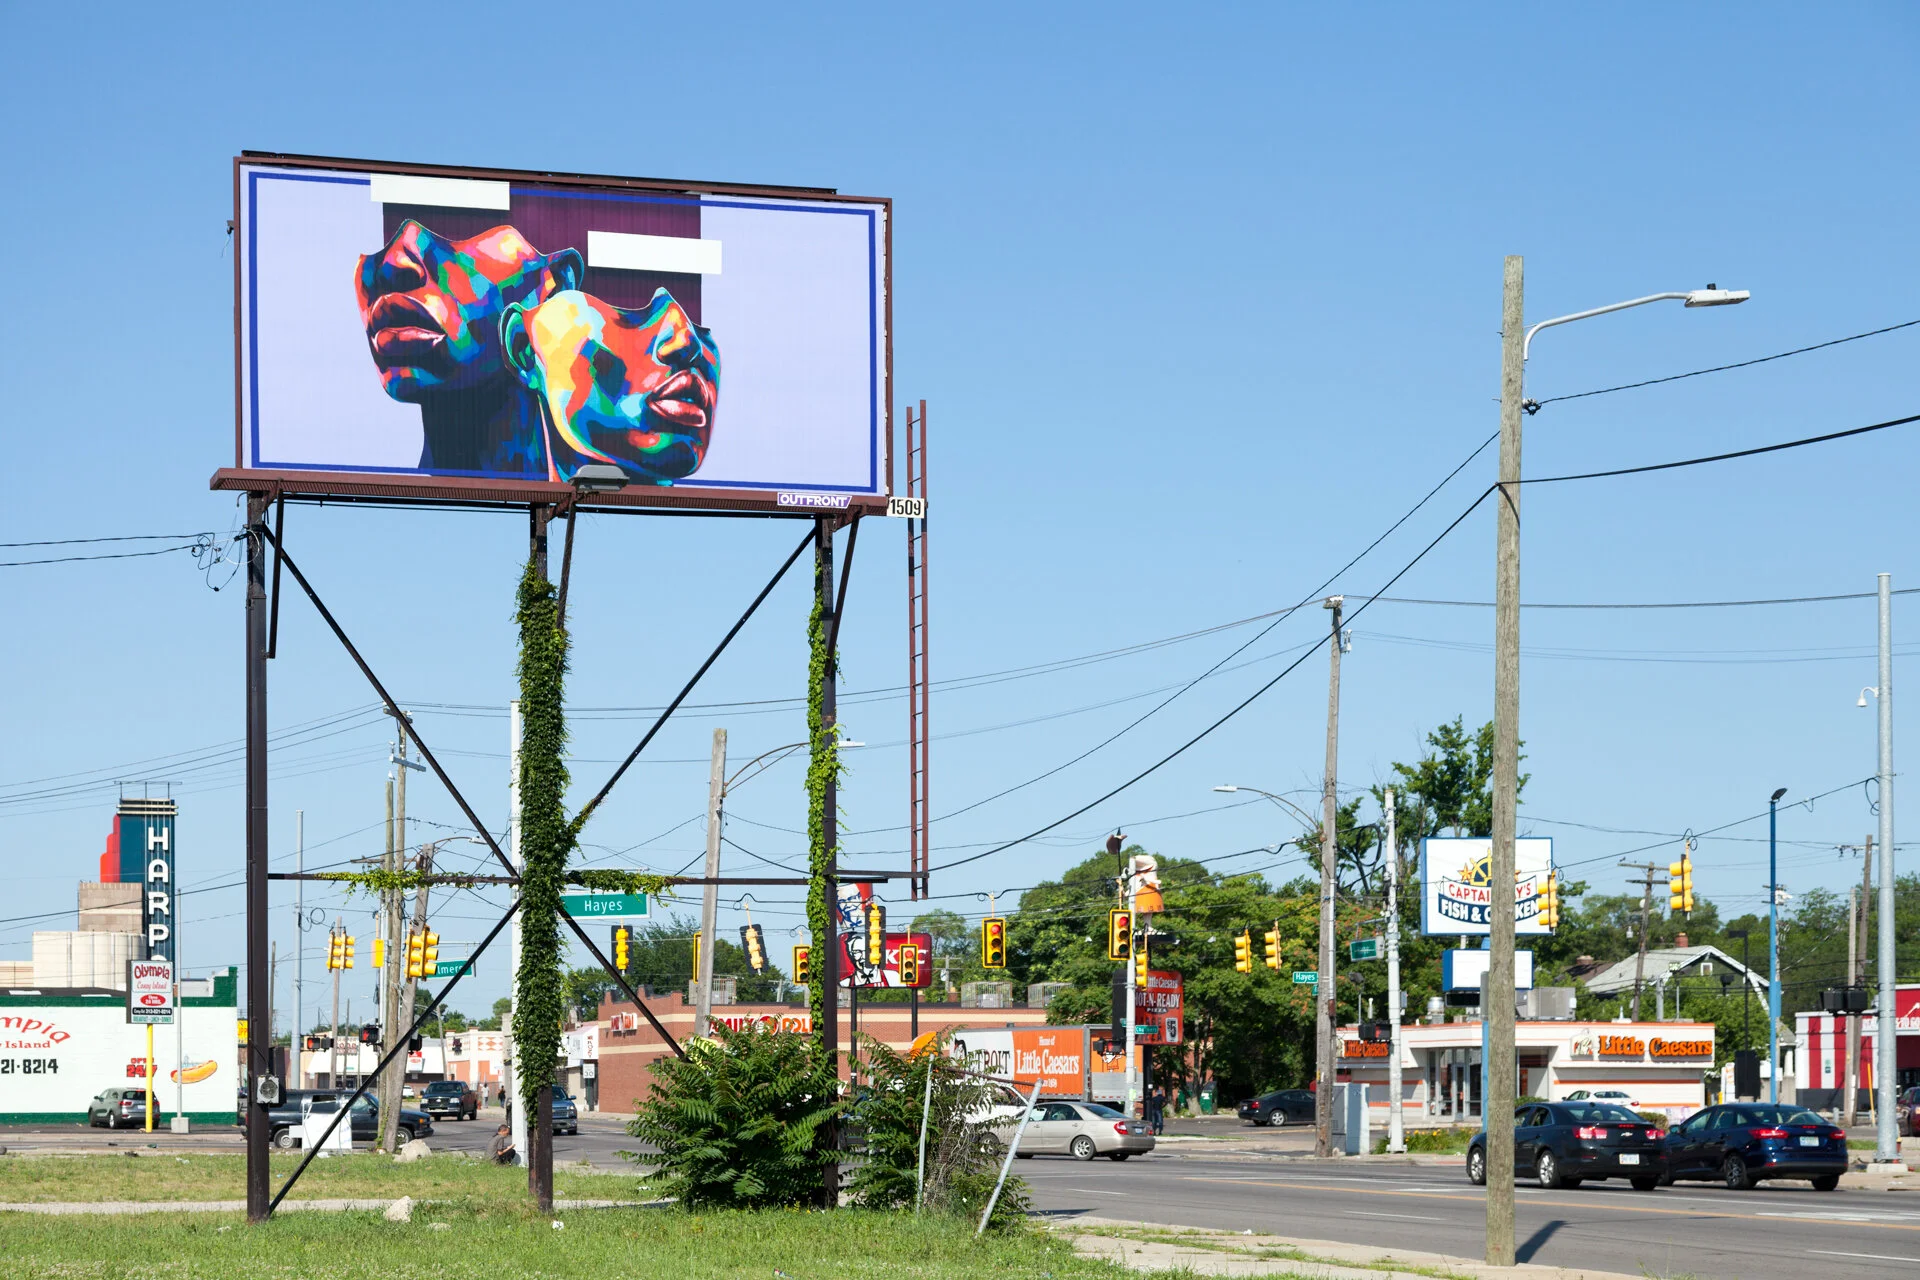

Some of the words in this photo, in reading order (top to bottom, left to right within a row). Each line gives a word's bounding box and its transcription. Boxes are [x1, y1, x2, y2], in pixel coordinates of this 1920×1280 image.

[779, 493, 848, 507] OUTFRONT
[890, 498, 921, 516] 1509
[147, 826, 170, 960] HARP
[1448, 884, 1490, 902] CAPTAI
[584, 900, 623, 914] Hayes
[1441, 898, 1469, 920] FISH
[1471, 906, 1482, 922] &
[886, 949, 928, 964] KC
[1295, 973, 1316, 983] Hayes
[5, 1040, 51, 1048] Island
[1599, 1035, 1645, 1055] Little
[1649, 1037, 1713, 1057] Caesars
[1016, 1050, 1041, 1074] Little
[1042, 1049, 1080, 1074] Caesars
